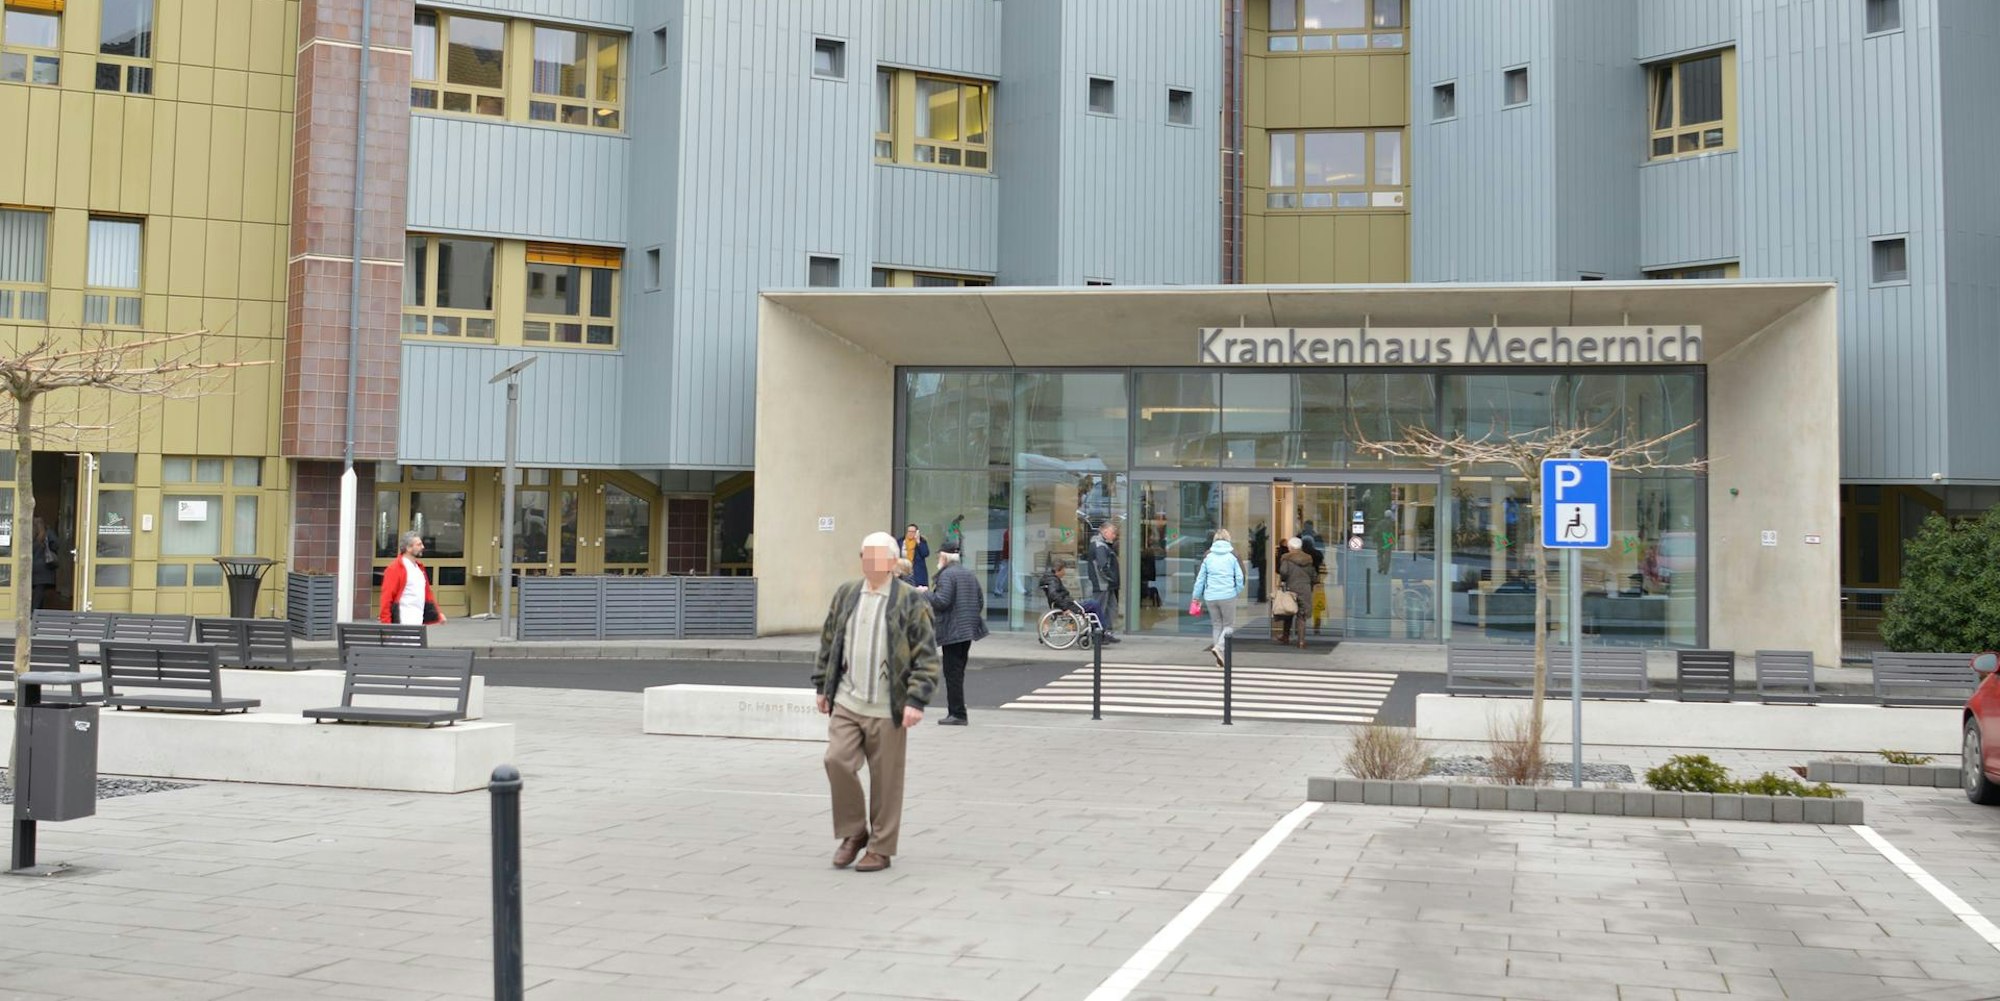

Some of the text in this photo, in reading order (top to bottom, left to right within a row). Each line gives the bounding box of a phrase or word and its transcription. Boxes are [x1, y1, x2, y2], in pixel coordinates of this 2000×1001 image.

[1199, 326, 1702, 363] Krankenhaus Mechernich
[1555, 464, 1582, 501] P
[738, 701, 754, 712] Dr.
[756, 702, 784, 713] Hans
